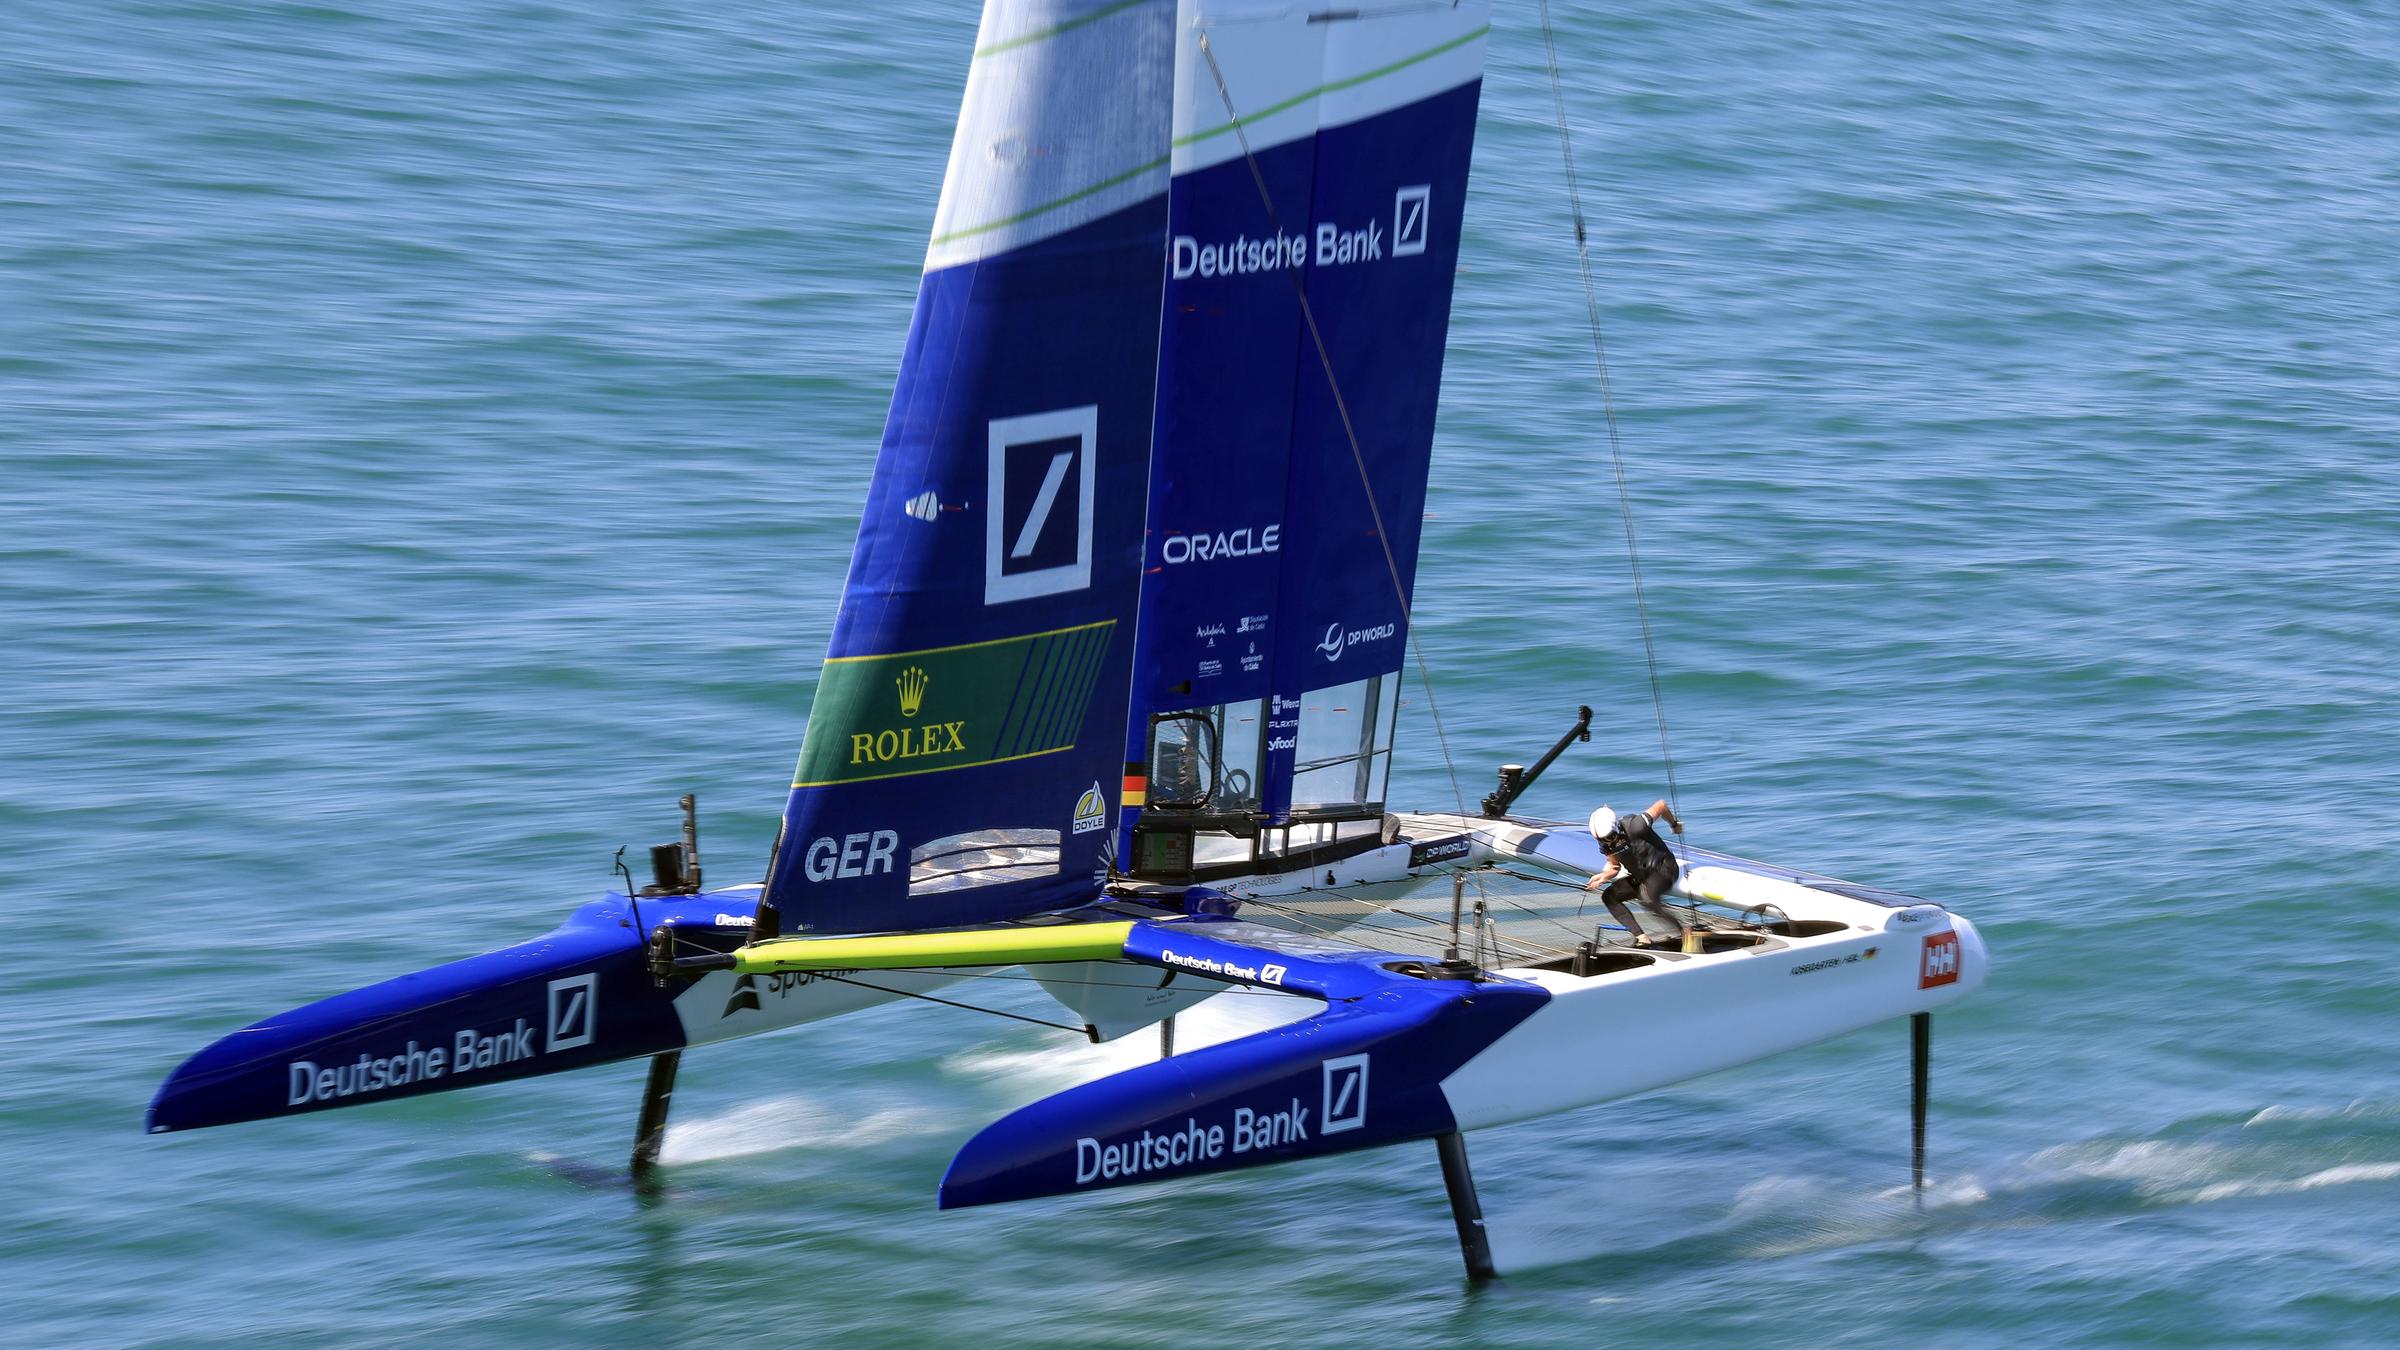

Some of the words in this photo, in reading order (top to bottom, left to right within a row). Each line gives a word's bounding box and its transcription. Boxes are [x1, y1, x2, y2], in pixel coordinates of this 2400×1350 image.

[1172, 227, 1307, 280] Deutsche
[1315, 218, 1384, 266] Bank
[1162, 523, 1281, 565] ORACLE
[1347, 630, 1361, 646] DP
[1361, 622, 1395, 643] WORLD
[850, 720, 966, 764] ROLEX
[1074, 817, 1104, 831] DOYLE
[804, 829, 898, 883] GER
[714, 913, 757, 928] Deuts
[1161, 949, 1222, 974] Deutsche
[1223, 962, 1258, 981] Bank
[287, 1040, 449, 1107] Deutsche
[452, 1017, 537, 1075] Bank
[1075, 1117, 1225, 1184] Deutsche
[1231, 1097, 1310, 1154] Bank
